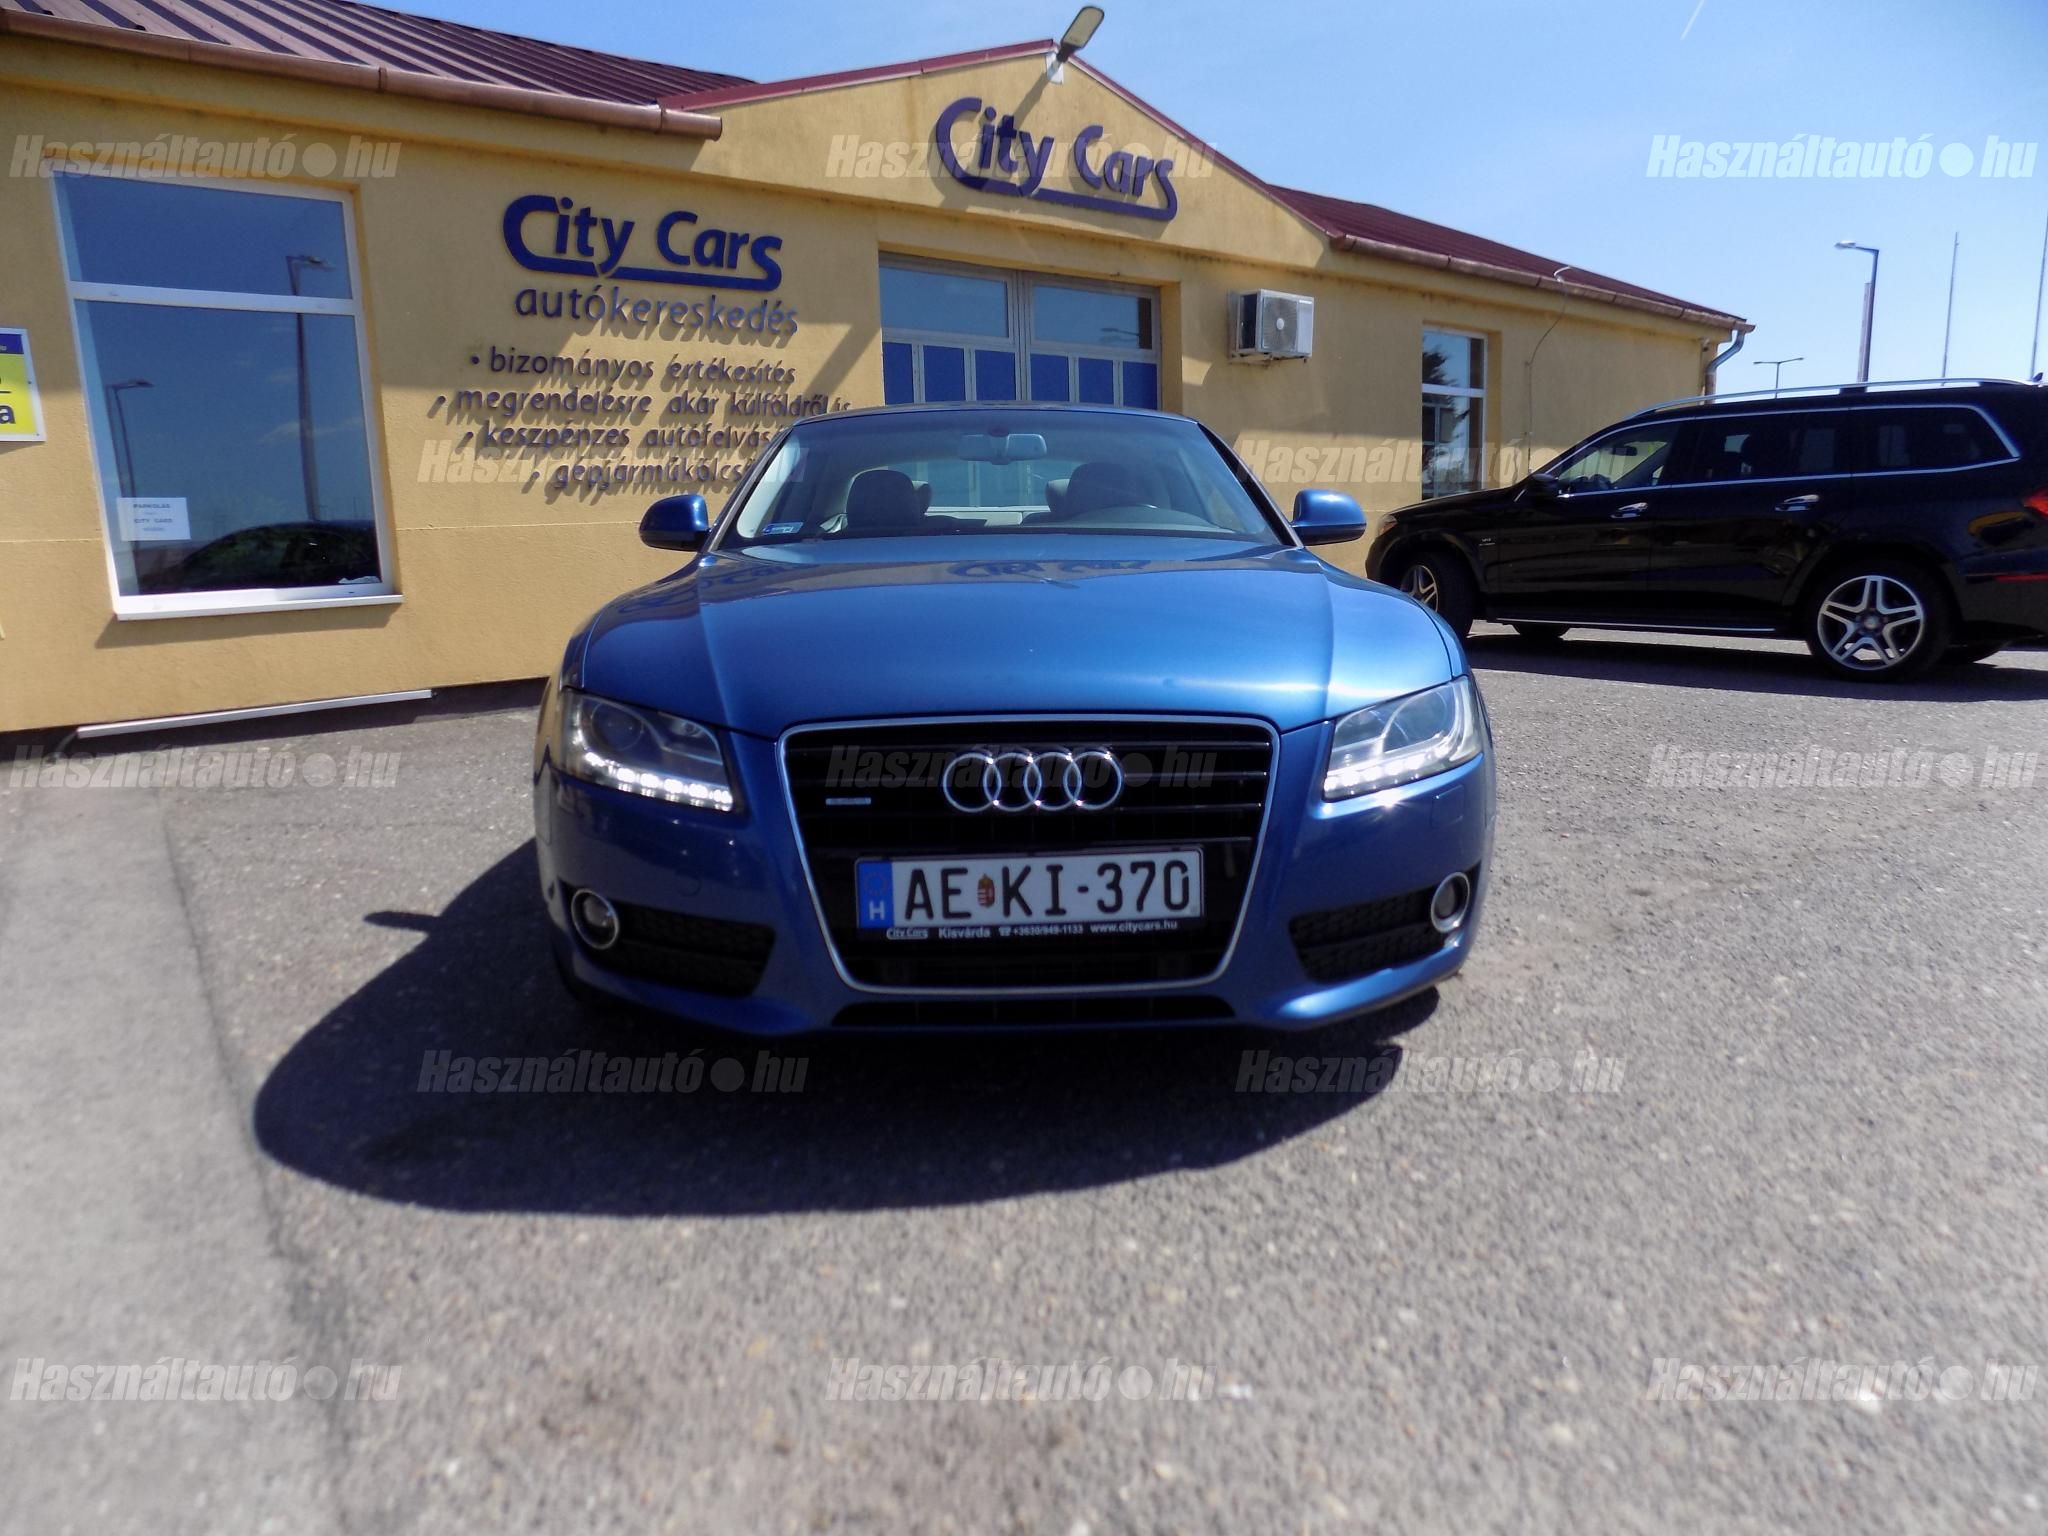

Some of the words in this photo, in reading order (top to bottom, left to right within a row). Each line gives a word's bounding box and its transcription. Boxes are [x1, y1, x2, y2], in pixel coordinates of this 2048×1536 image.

[935, 97, 1054, 197] City
[1073, 124, 1178, 221] Cars
[503, 195, 635, 278] City
[656, 210, 783, 292] Cars
[515, 285, 798, 336] autókereskedés
[490, 345, 655, 382] bizományos
[668, 353, 796, 385] értékesítés
[457, 386, 652, 417] megrendelésre
[669, 389, 719, 415] akár
[869, 901, 885, 920] H
[904, 867, 972, 920] AE
